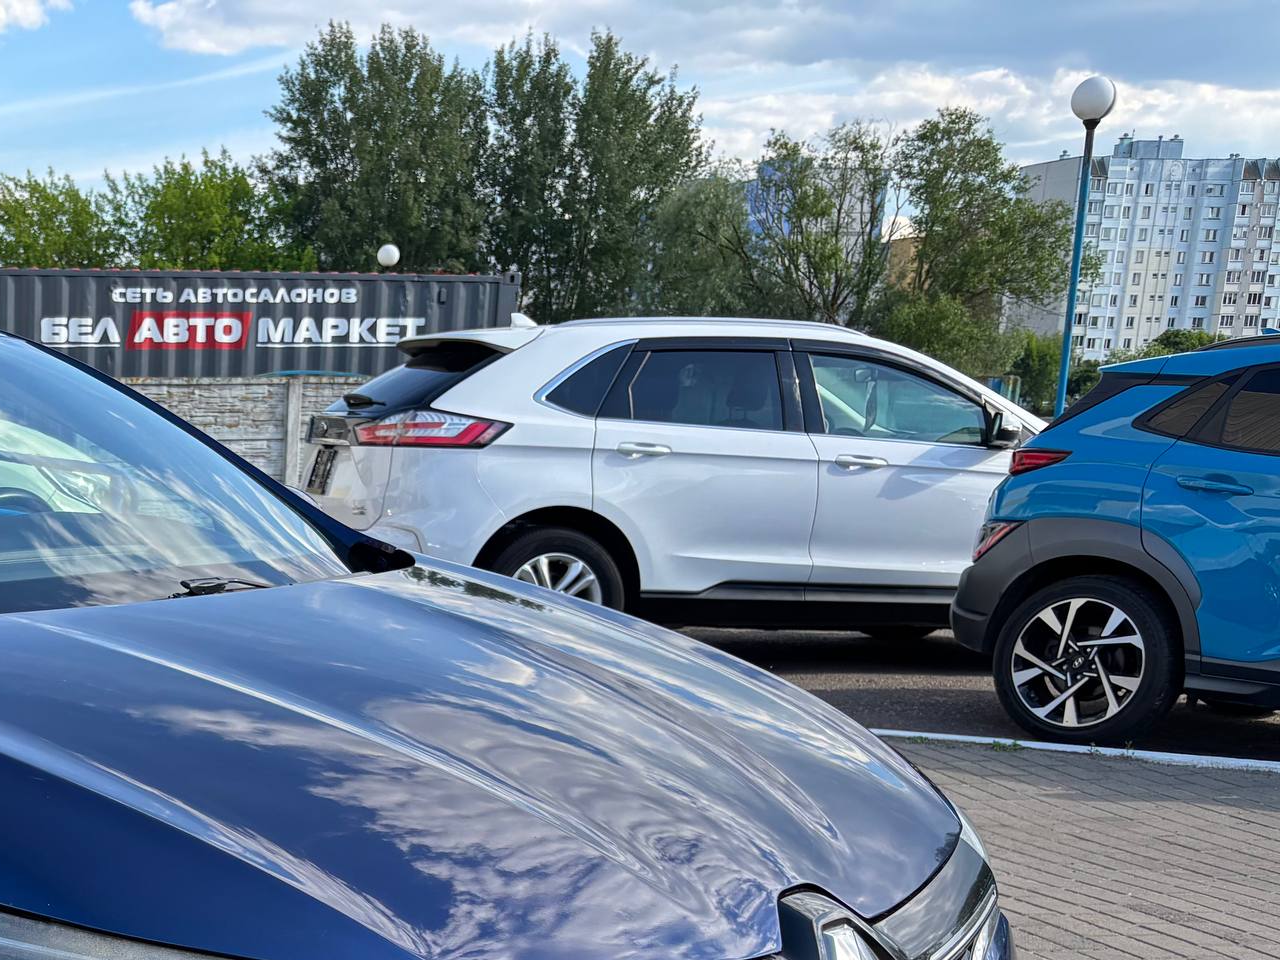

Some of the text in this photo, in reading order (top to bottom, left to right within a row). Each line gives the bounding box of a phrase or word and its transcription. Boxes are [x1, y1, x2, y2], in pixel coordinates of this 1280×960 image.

[112, 287, 358, 304] СЕТЬ АВТОСАЛОНОВ
[40, 316, 426, 344] БЕЛ АВТО МАРКЕТ
